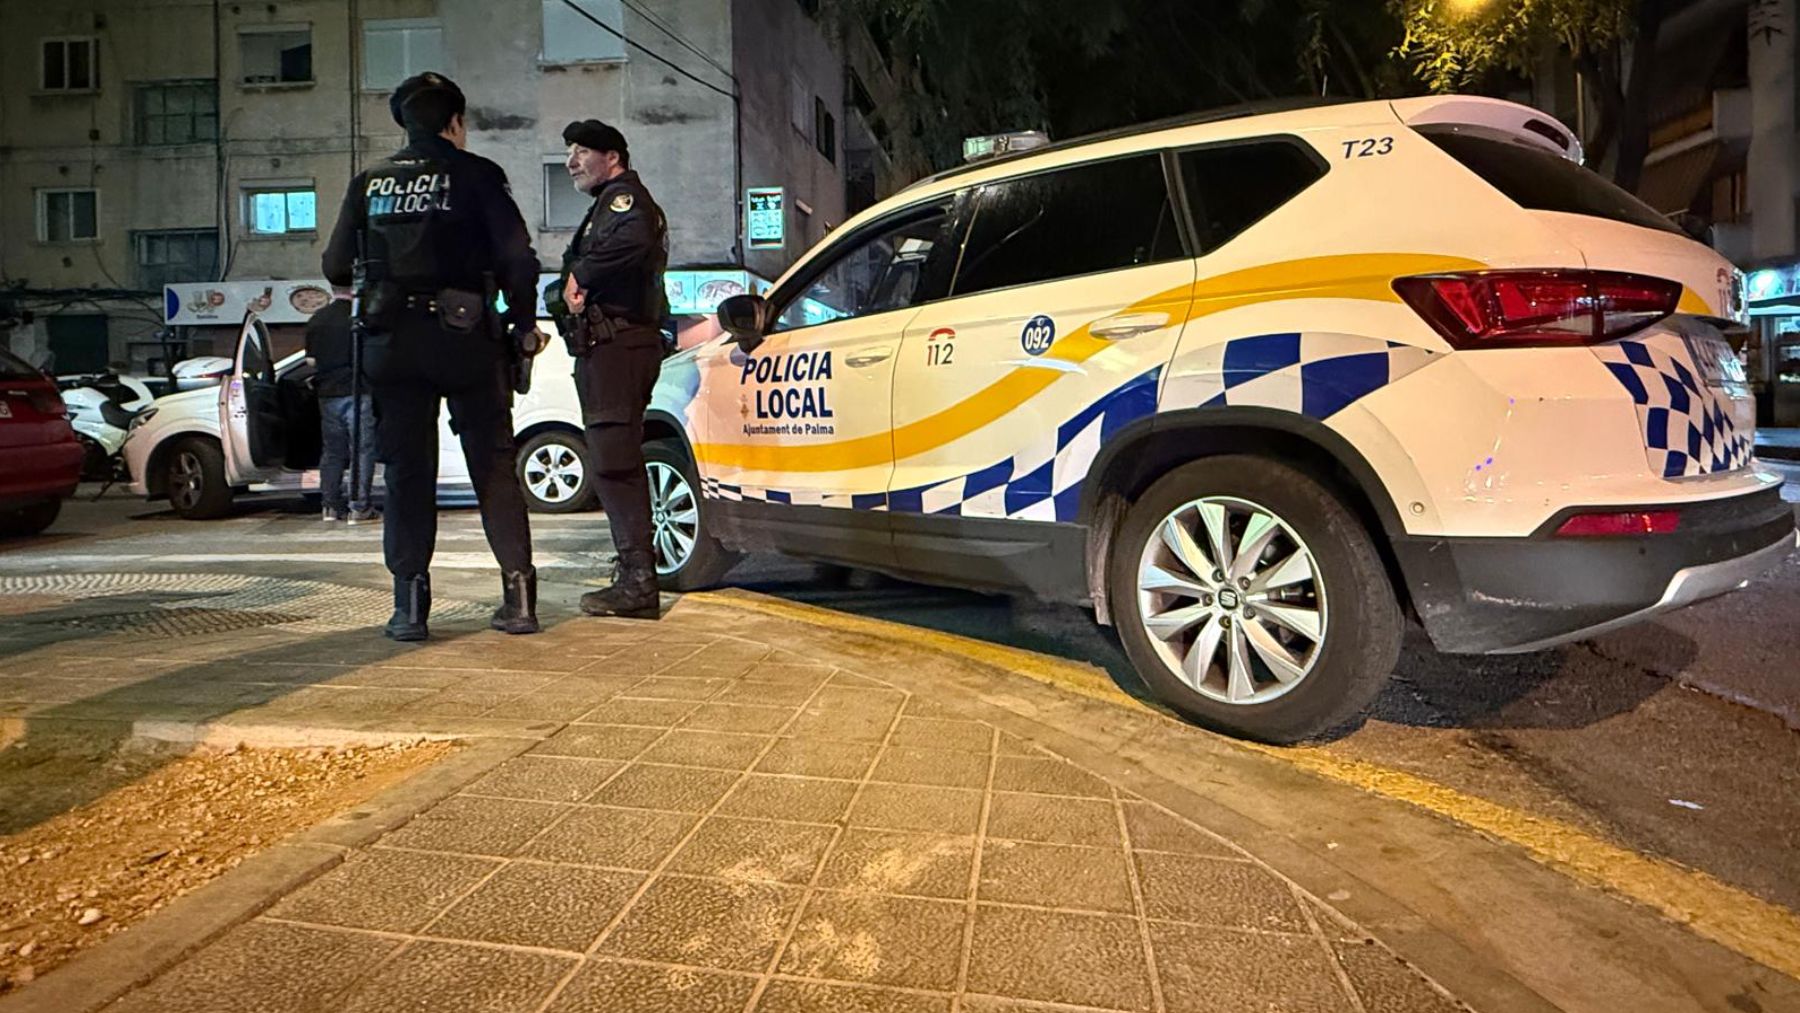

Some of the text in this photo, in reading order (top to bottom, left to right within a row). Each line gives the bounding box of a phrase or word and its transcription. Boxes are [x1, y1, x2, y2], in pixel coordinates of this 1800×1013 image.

[1341, 136, 1394, 159] T23
[394, 193, 452, 213] LOCL
[1024, 326, 1051, 351] 092
[927, 343, 954, 367] 112
[740, 351, 833, 386] POLICIA
[756, 387, 834, 419] LOCAL
[743, 423, 835, 437] Ajuntament de Palma
